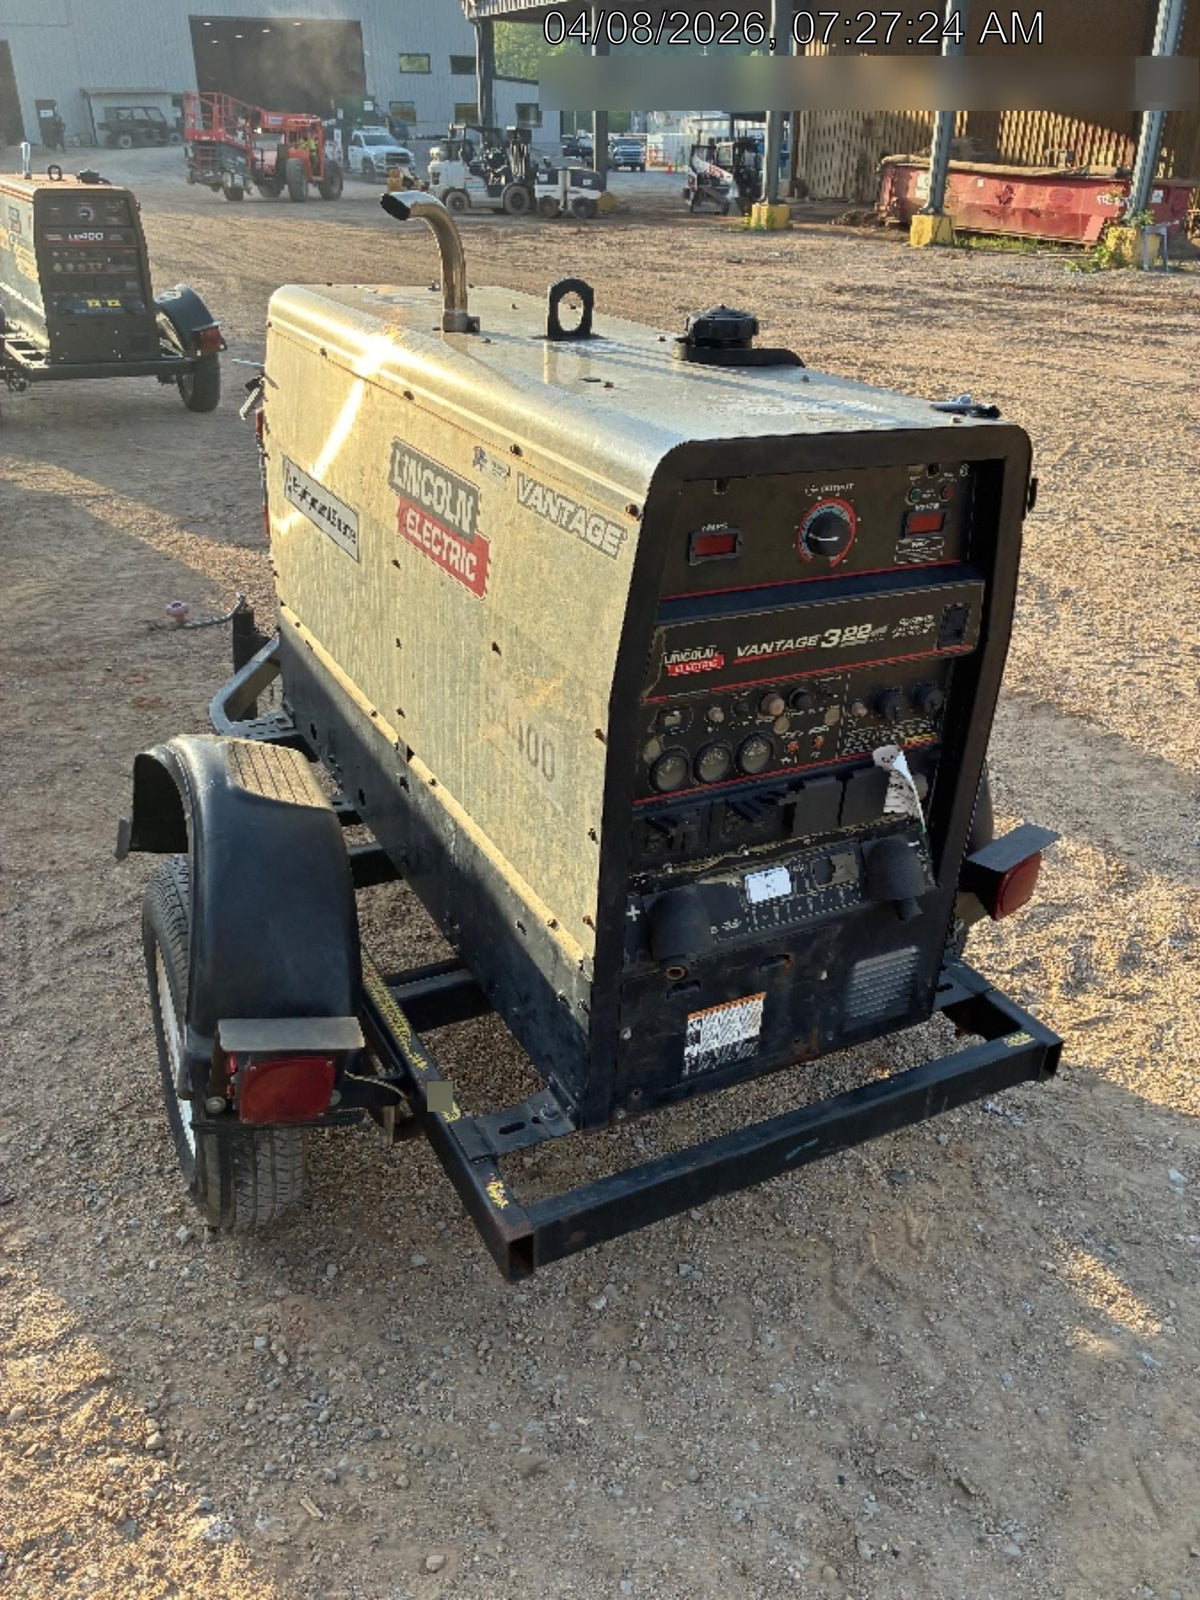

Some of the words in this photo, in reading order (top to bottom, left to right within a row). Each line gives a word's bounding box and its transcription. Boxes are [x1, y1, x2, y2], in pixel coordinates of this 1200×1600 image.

[393, 449, 474, 535] LINCOLN
[517, 473, 624, 559] VANTAGE
[405, 508, 478, 583] ELECTRIC
[664, 648, 716, 666] LINCOLN
[736, 634, 819, 658] VANTAGE
